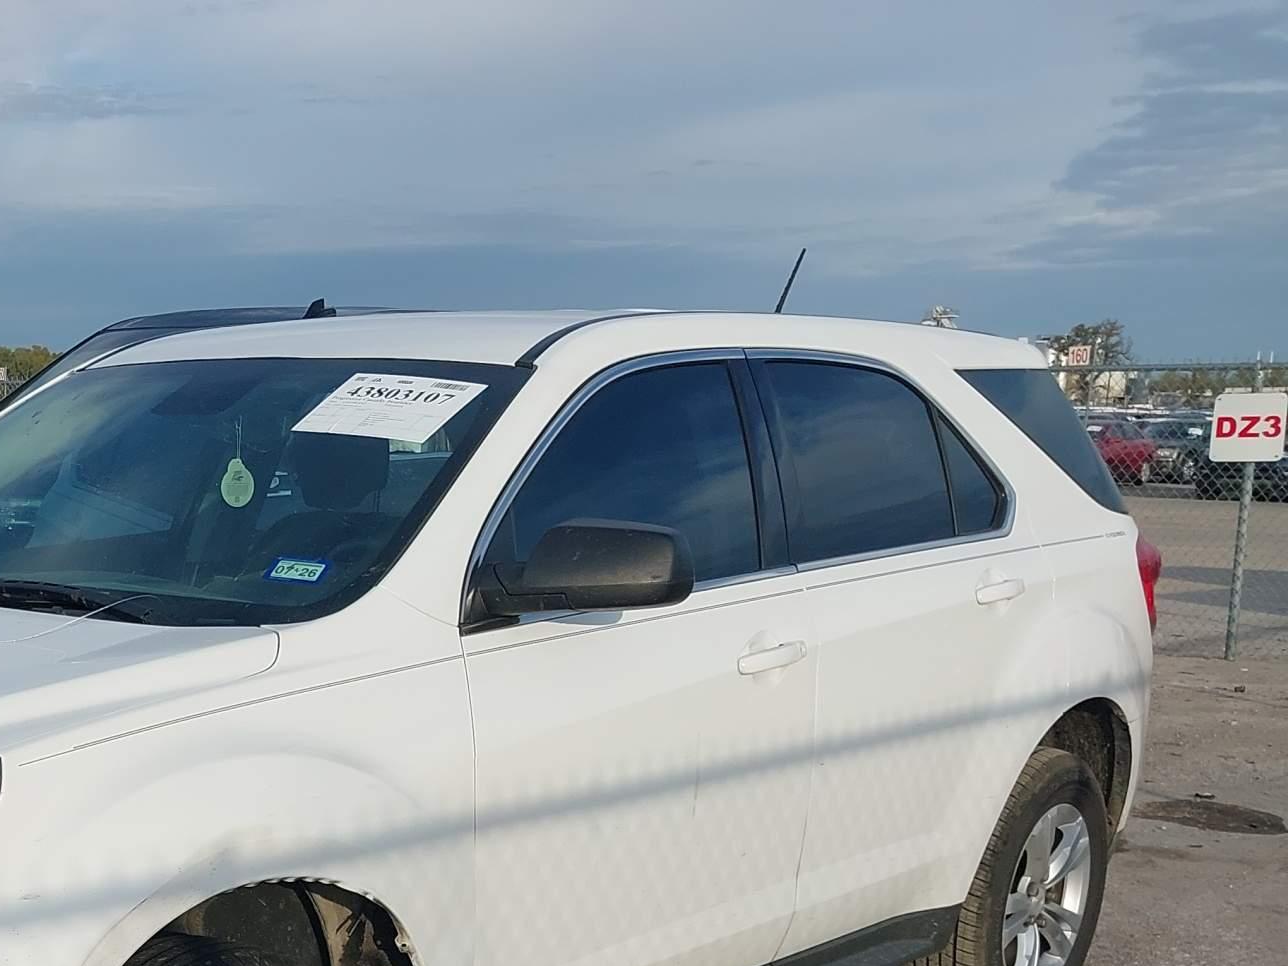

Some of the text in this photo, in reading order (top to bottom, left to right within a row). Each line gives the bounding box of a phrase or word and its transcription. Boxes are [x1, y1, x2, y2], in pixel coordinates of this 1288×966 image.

[1071, 348, 1088, 364] 160
[347, 385, 456, 405] 43803107
[1215, 415, 1282, 438] DZ3
[298, 567, 319, 578] 26
